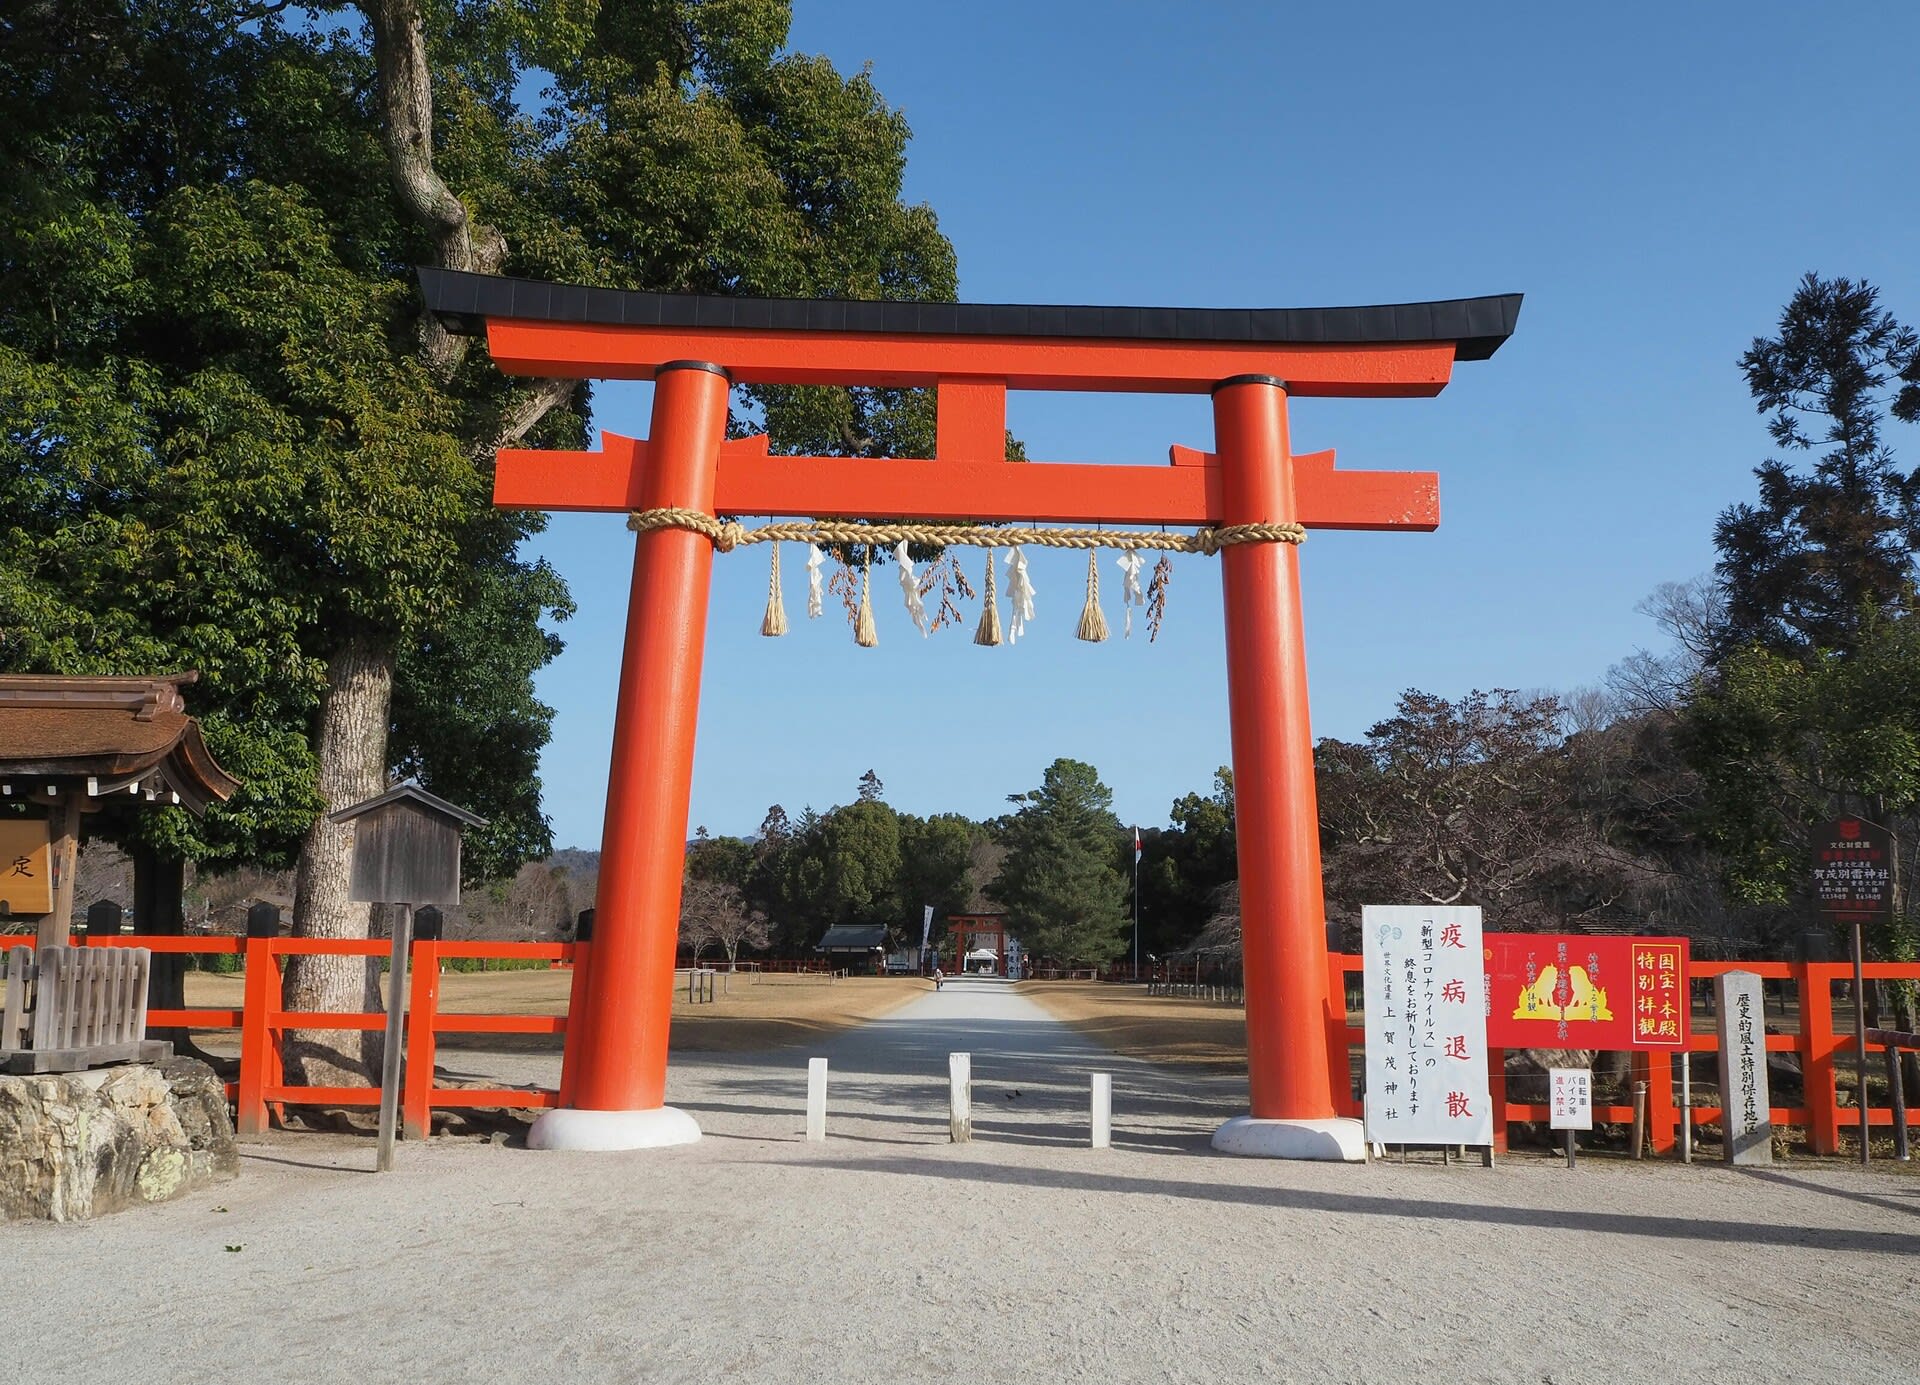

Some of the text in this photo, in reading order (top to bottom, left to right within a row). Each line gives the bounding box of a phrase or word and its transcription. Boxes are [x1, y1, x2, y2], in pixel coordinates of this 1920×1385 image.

[11, 855, 34, 878] 定
[1814, 868, 1889, 880] 賀茂別雷神社
[1383, 951, 1392, 1000] 世界文化遺産
[1421, 919, 1436, 1067] 「新型コロナウイルス」の
[1637, 951, 1658, 1036] 特別拝観
[1658, 953, 1678, 1037] 国宝・本殿
[1404, 958, 1419, 1115] 終息をお祈りしております
[1440, 923, 1473, 1118] 疫病退散
[1382, 1006, 1399, 1120] 上賀茂神社
[1555, 1076, 1565, 1116] 進入禁止
[1567, 1076, 1577, 1116] バイク等
[1578, 1076, 1587, 1106] 自転車
[1736, 993, 1758, 1135] 歴史的風土特別保存地区
